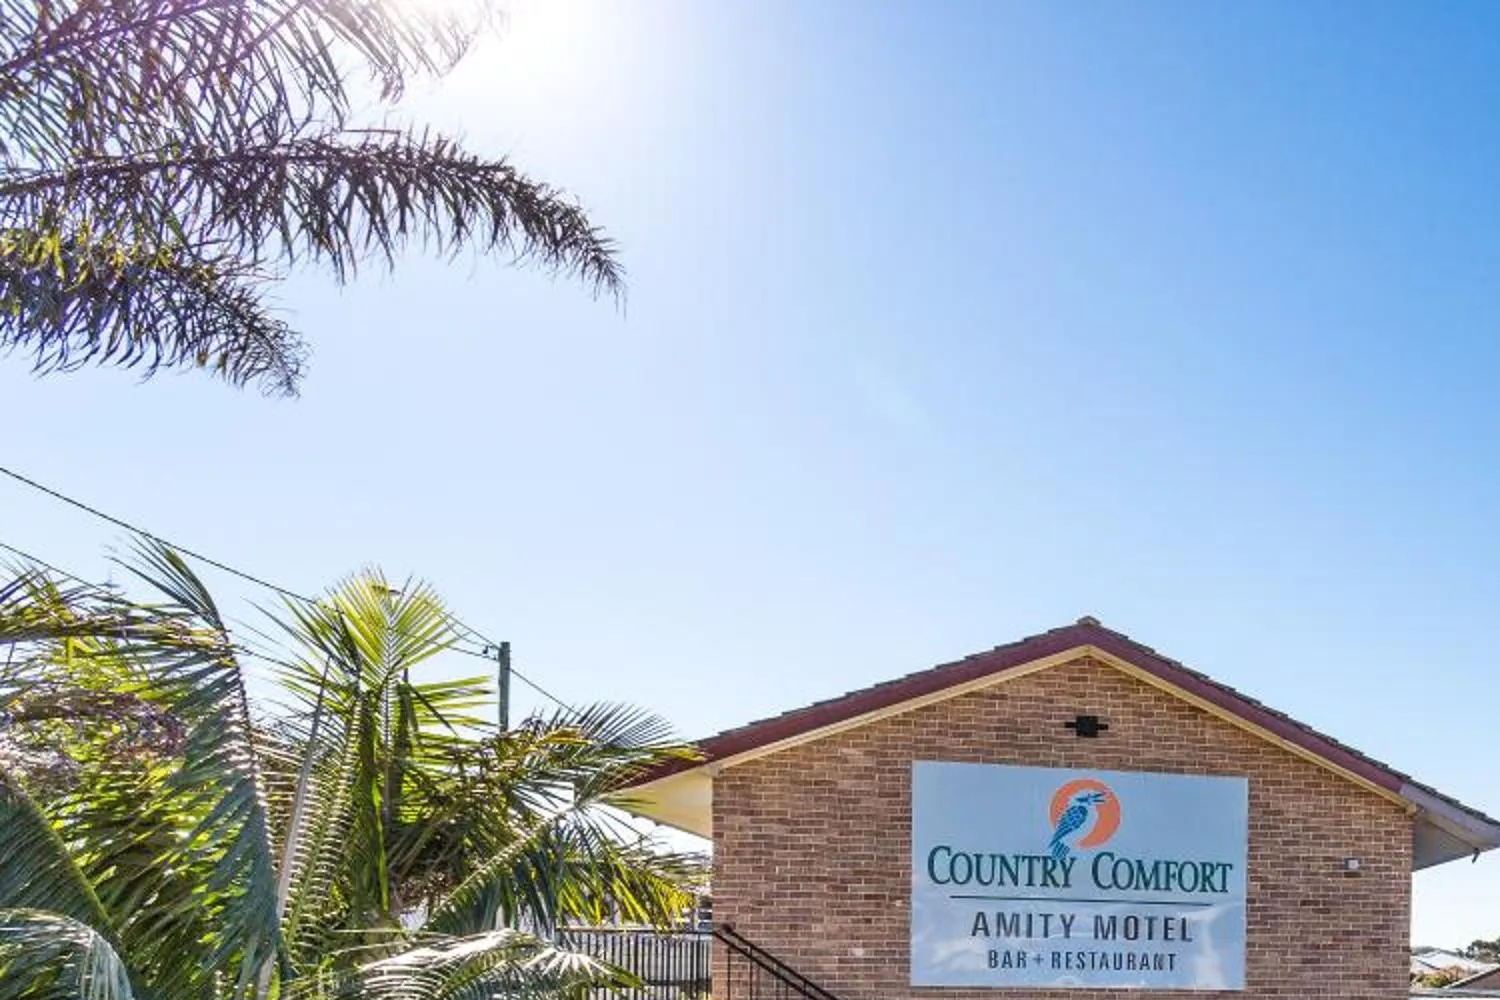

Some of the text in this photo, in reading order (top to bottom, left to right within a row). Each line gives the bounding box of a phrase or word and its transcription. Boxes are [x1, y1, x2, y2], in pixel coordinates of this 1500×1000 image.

[927, 845, 1233, 893] COUNTRY COMFORT
[971, 911, 1193, 942] AMITY MOTEL
[988, 949, 1177, 972] BAR + RESTAURANT
